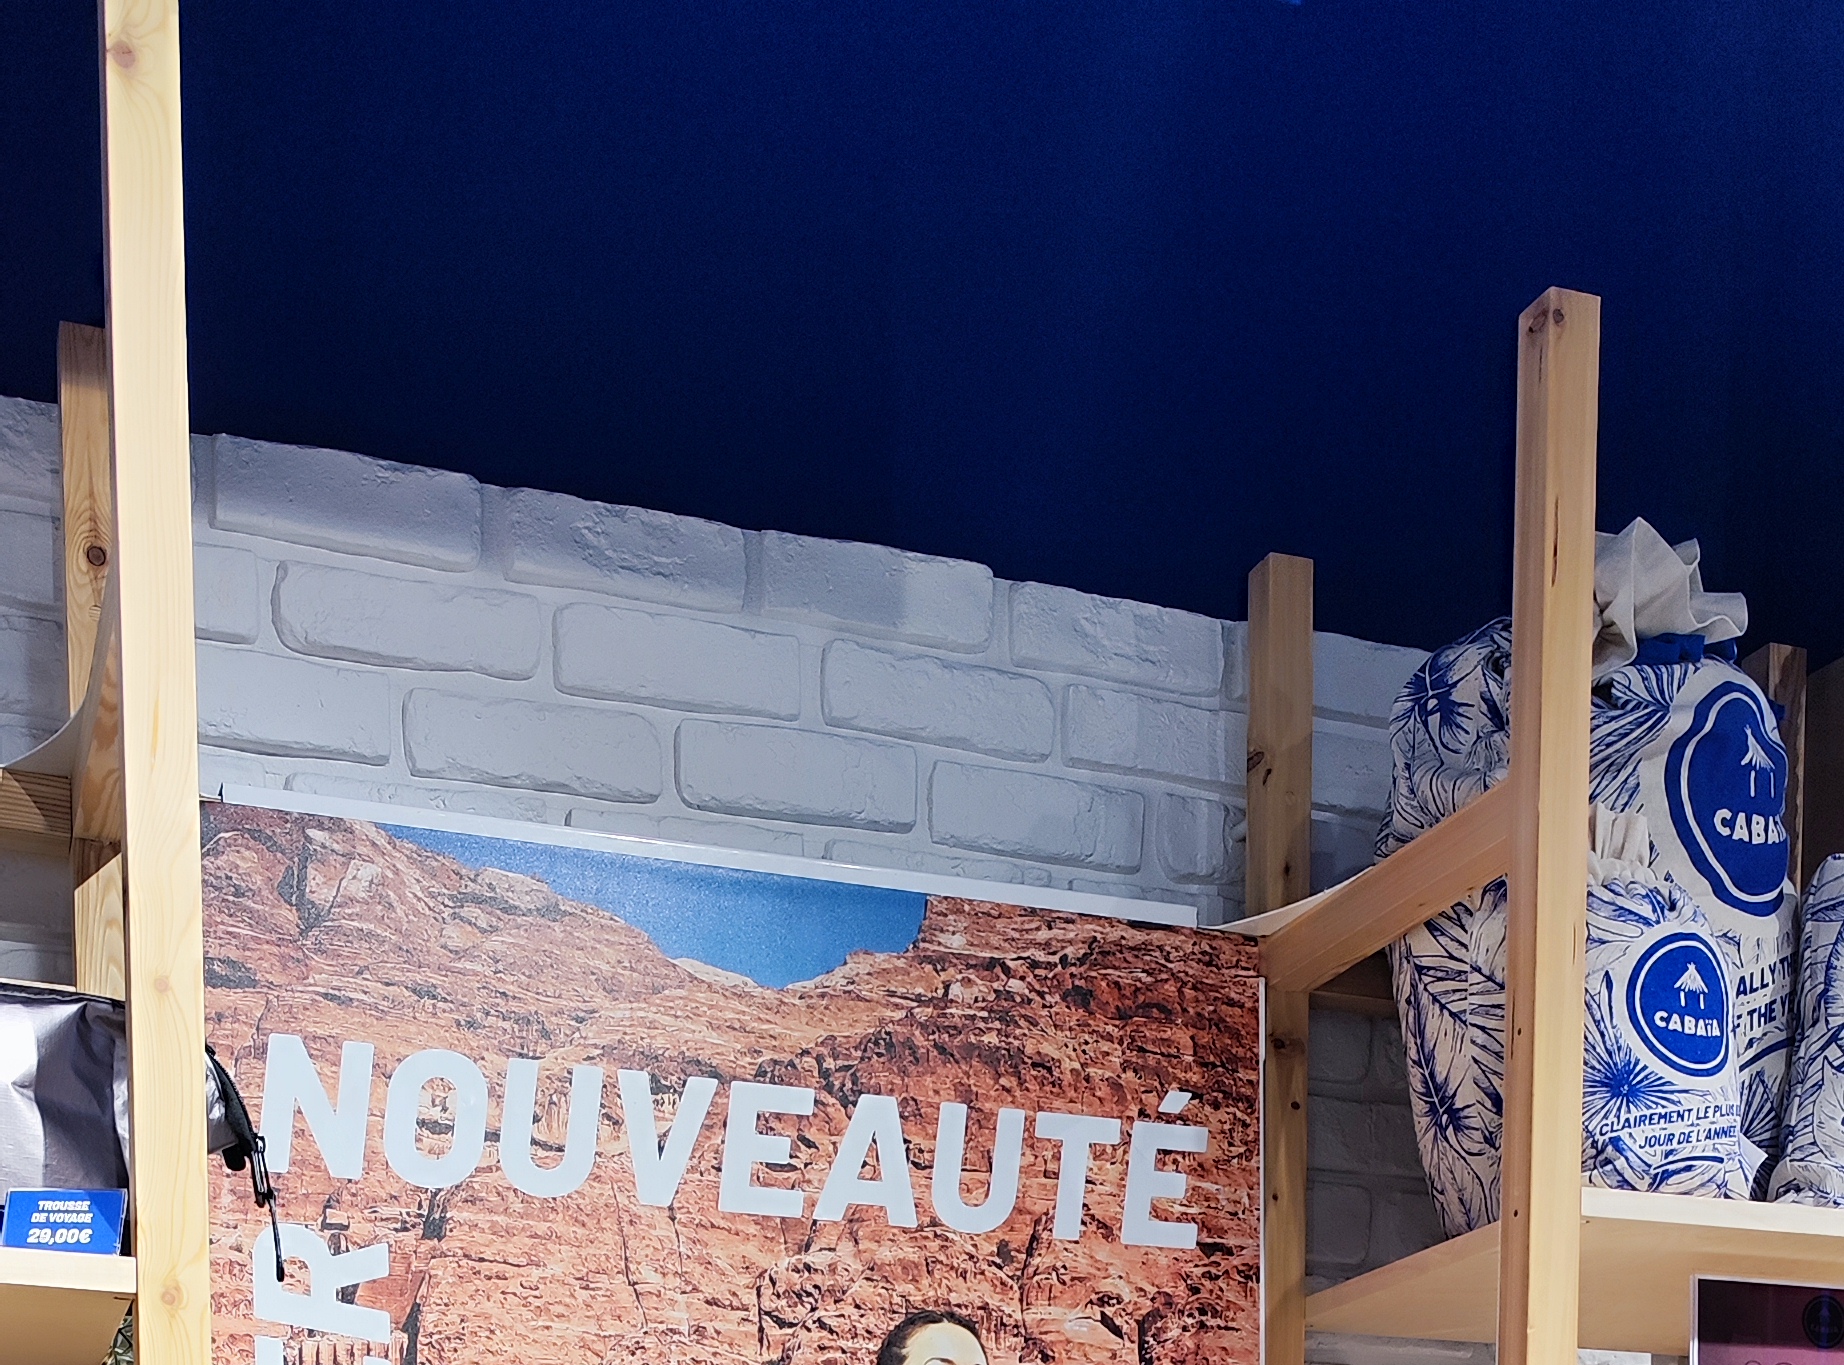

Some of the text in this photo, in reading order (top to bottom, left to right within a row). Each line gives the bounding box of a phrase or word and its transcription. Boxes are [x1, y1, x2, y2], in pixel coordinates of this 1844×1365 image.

[1735, 960, 1777, 1000] ALLY
[1746, 998, 1778, 1033] THE
[1598, 1107, 1694, 1137] CLAIREMENT
[1695, 1105, 1710, 1121] LE
[1712, 1103, 1735, 1119] PLUS
[257, 1032, 1210, 1249] NOUVEAUTÉ
[1638, 1132, 1676, 1150] JOUR
[1677, 1130, 1693, 1146] DE
[30, 1212, 94, 1224] DE VOYAGE
[37, 1200, 91, 1211] TROUSSE
[26, 1228, 93, 1245] 29,00€
